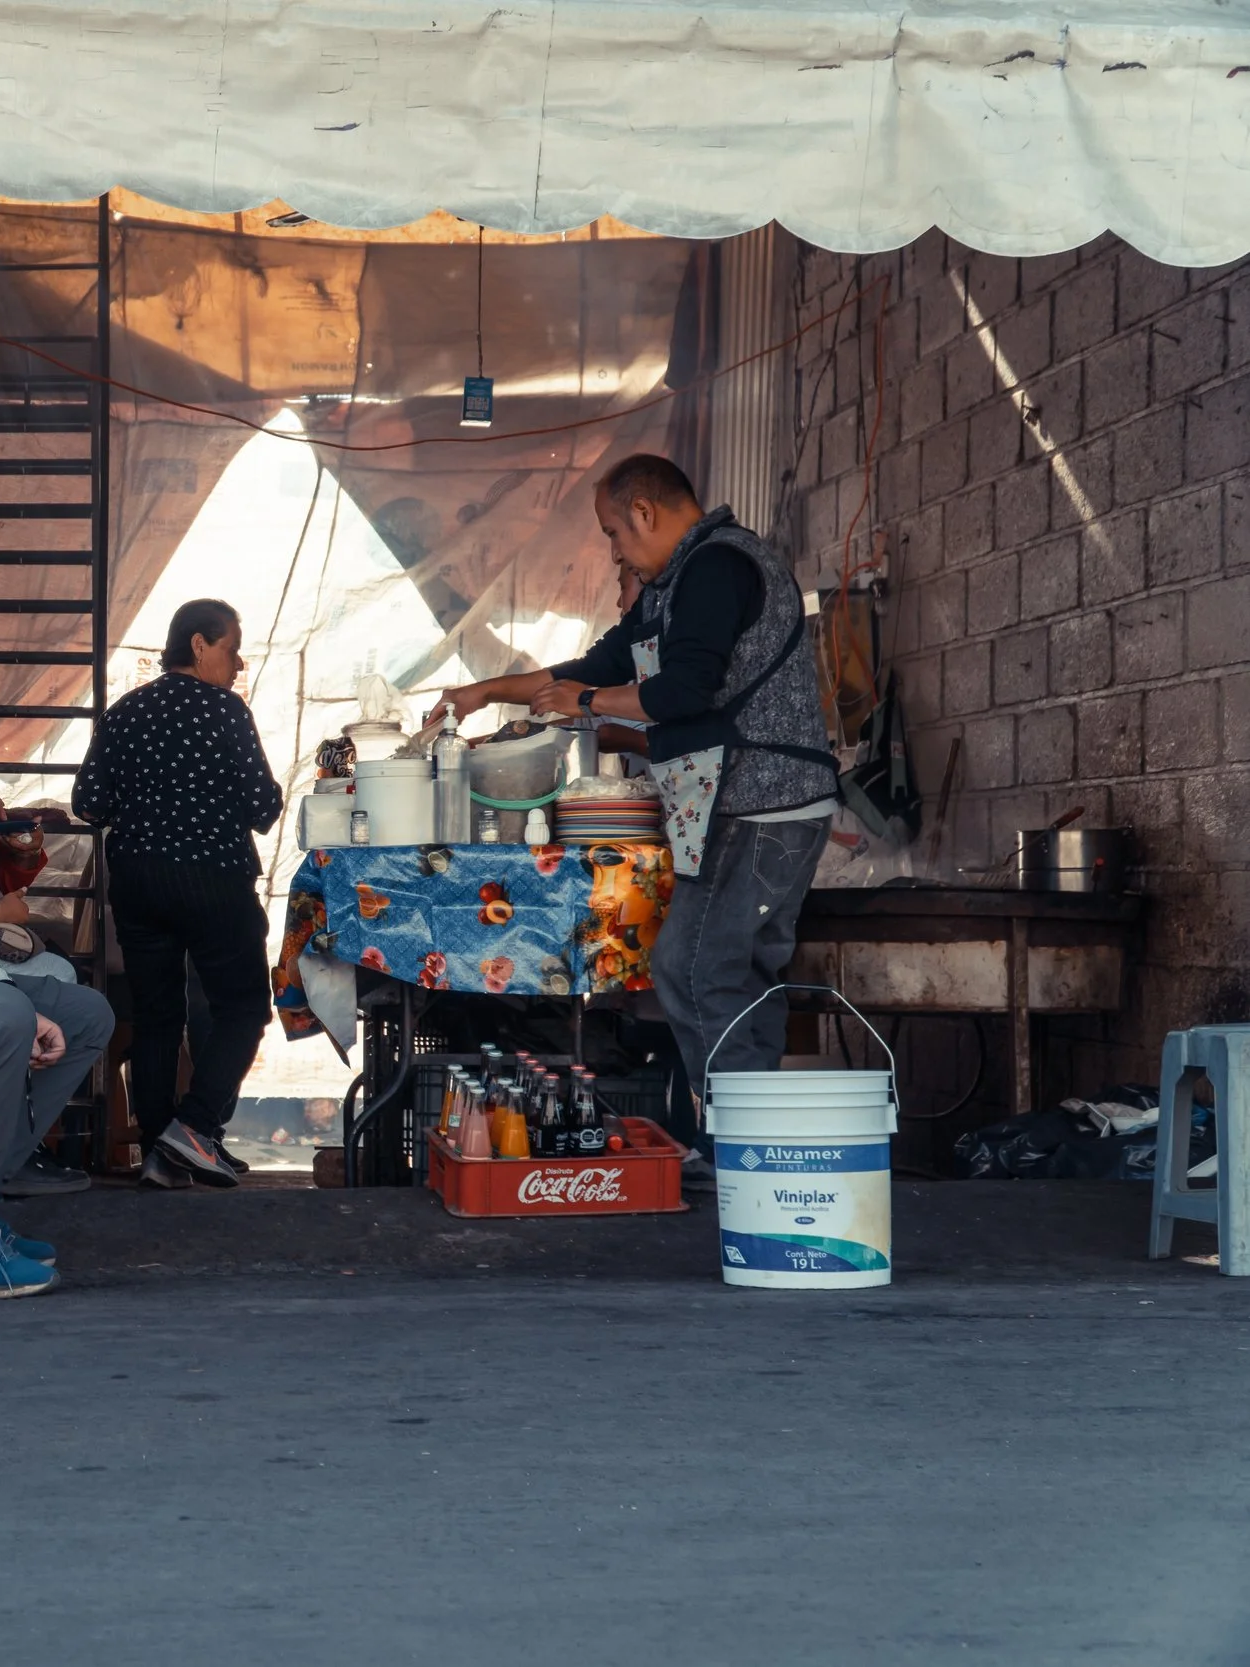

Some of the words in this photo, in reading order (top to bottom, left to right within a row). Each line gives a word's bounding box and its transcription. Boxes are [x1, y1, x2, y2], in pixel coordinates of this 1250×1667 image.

[765, 1147, 842, 1161] Alvamex
[776, 1164, 832, 1172] PINTURAS
[518, 1167, 624, 1204] Coca-Cola
[774, 1189, 836, 1206] Viniplax
[785, 1250, 806, 1258] Cont.
[807, 1250, 827, 1258] Neto
[792, 1258, 807, 1269] 19
[810, 1258, 822, 1269] L.
